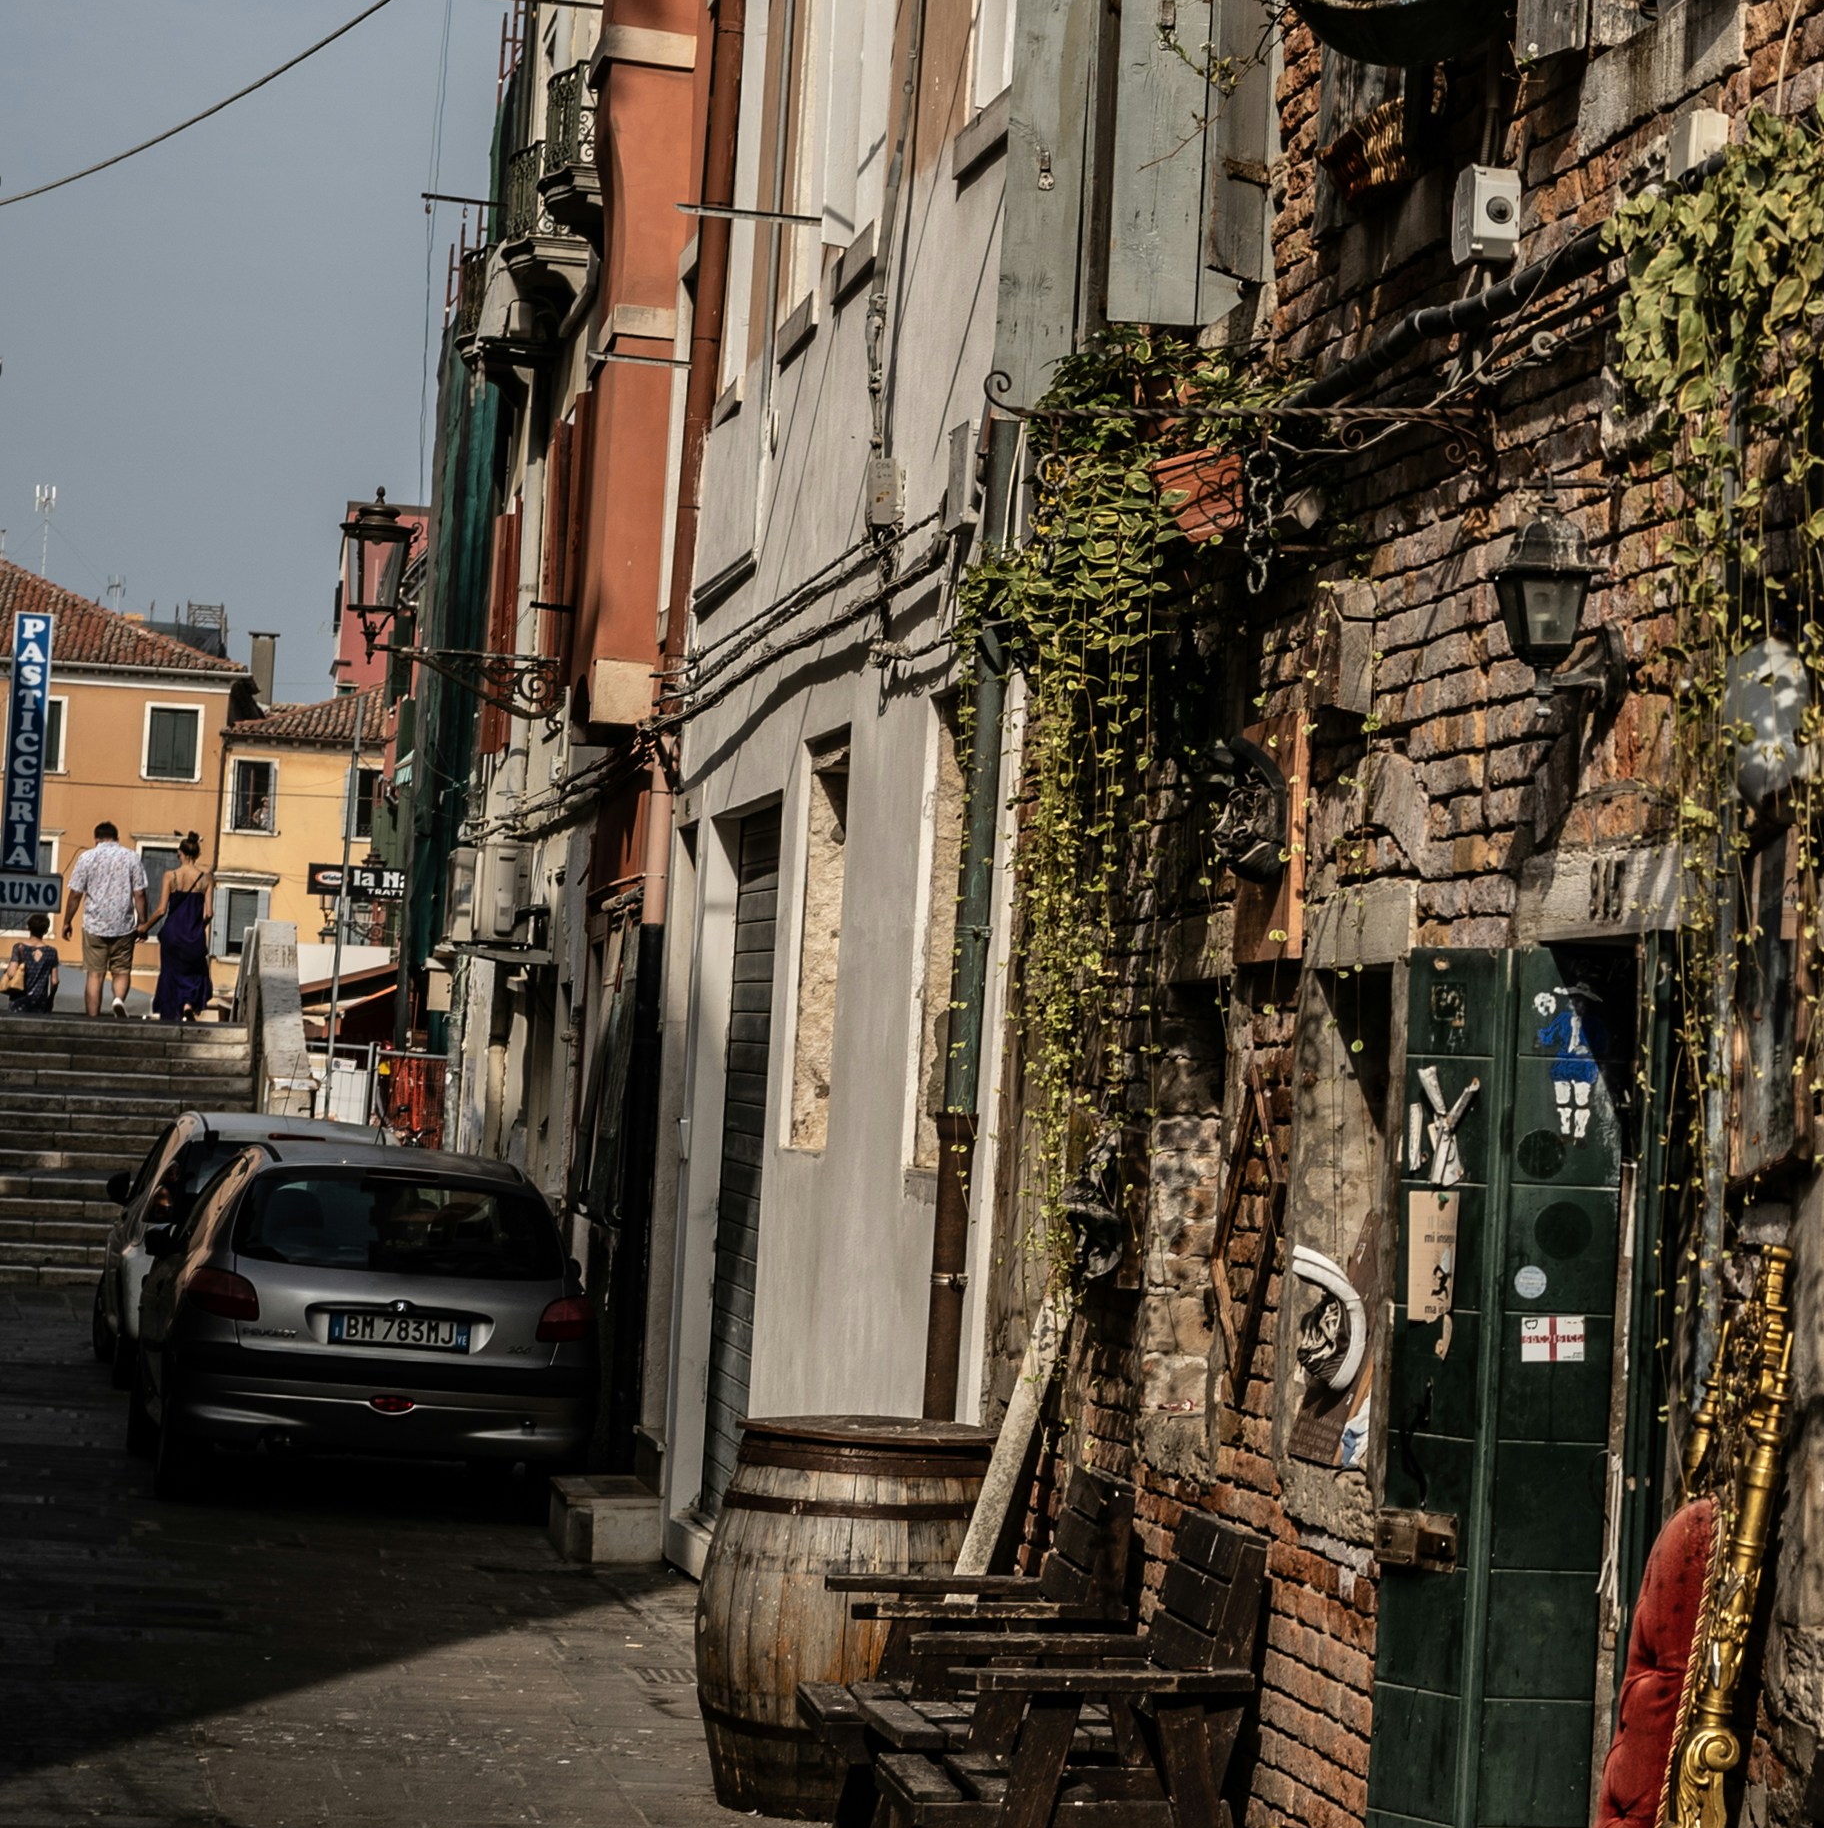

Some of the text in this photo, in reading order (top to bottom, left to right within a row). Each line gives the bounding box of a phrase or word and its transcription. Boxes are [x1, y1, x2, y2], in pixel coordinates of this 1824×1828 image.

[5, 618, 46, 866] PASTICCERIA
[353, 869, 375, 887] la
[1424, 1231, 1435, 1243] mi
[1425, 1305, 1436, 1314] ma
[242, 1327, 298, 1339] PEUGEOT
[346, 1314, 374, 1340] BM
[382, 1318, 456, 1345] 783MJ
[456, 1333, 469, 1347] VE
